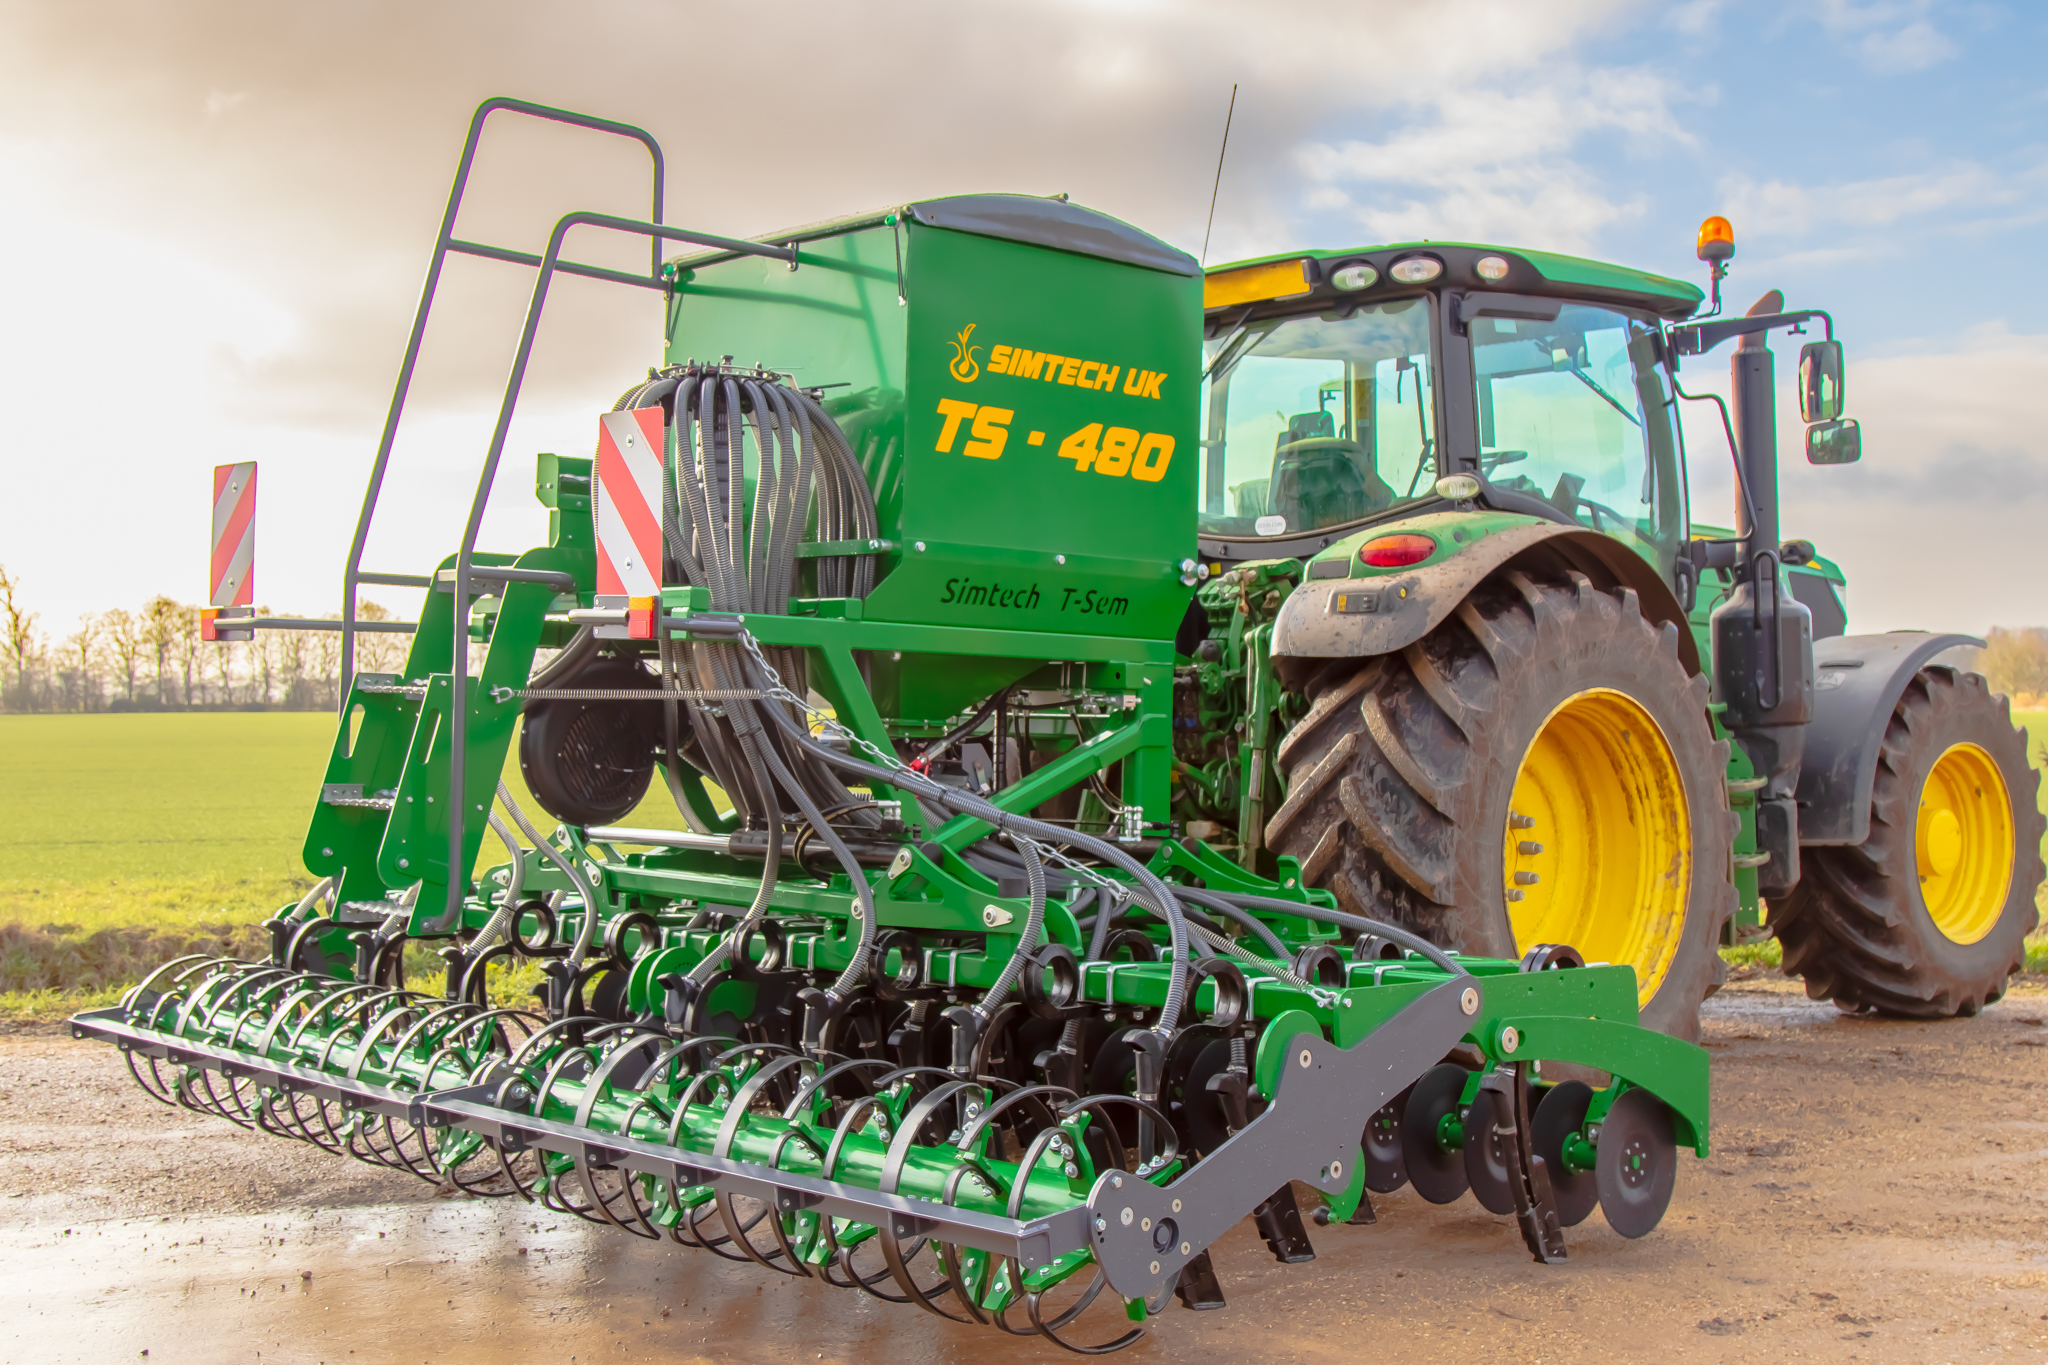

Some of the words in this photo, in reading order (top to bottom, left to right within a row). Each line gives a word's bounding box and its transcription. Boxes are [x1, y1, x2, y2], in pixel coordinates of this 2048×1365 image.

[987, 344, 1120, 392] SIMTECH
[1123, 367, 1168, 400] UK
[935, 398, 1015, 460] TS
[1057, 422, 1176, 482] 480
[940, 578, 1040, 610] Simtech
[1060, 587, 1130, 616] T-Sem
